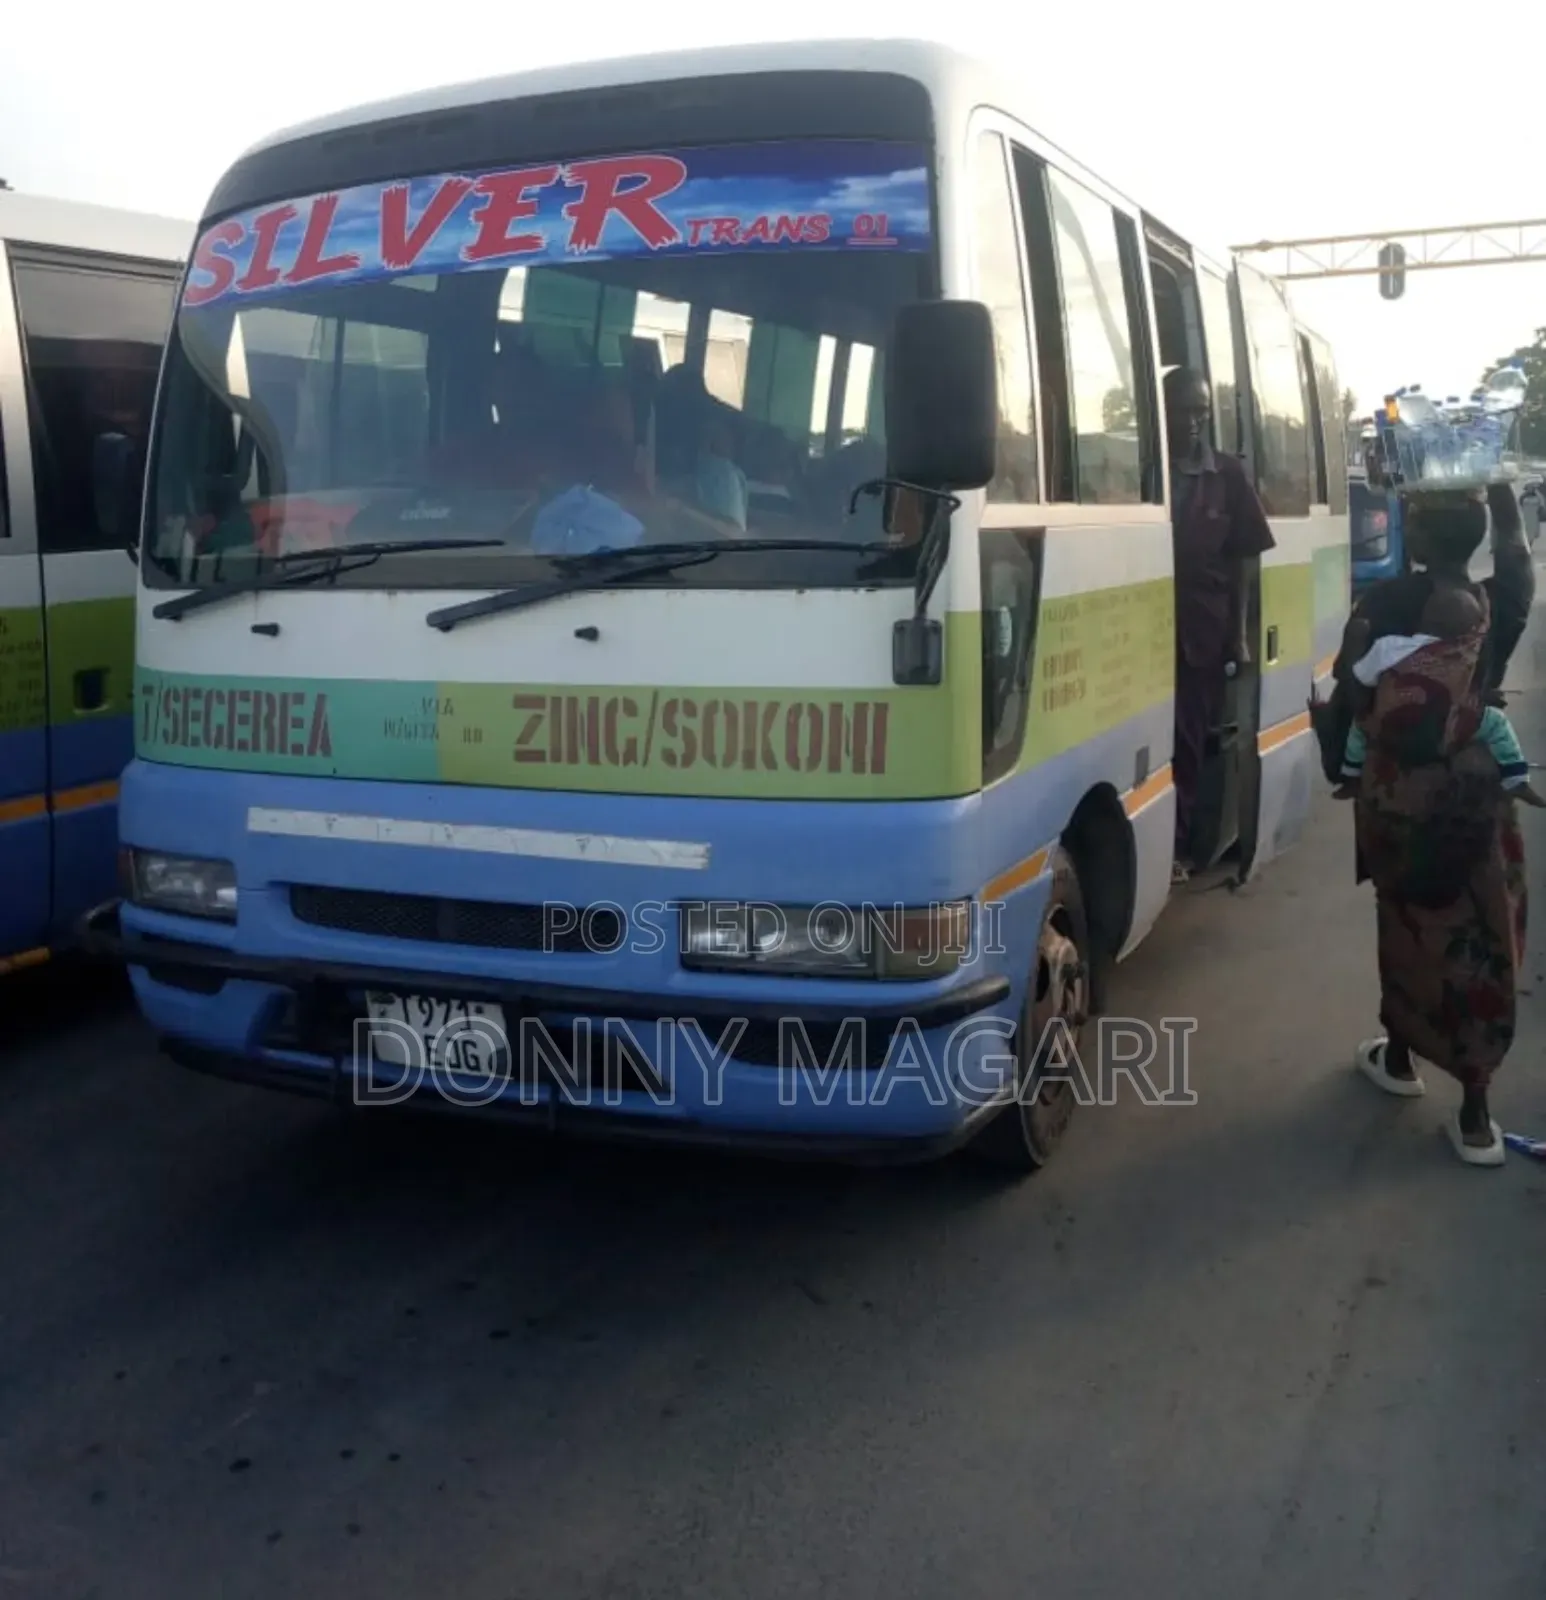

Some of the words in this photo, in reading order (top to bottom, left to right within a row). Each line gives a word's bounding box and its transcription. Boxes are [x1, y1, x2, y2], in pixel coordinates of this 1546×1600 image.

[182, 154, 689, 307] SILVER
[685, 211, 832, 247] TRANS
[852, 213, 889, 239] 01
[512, 689, 890, 775] ZING/SOKONI
